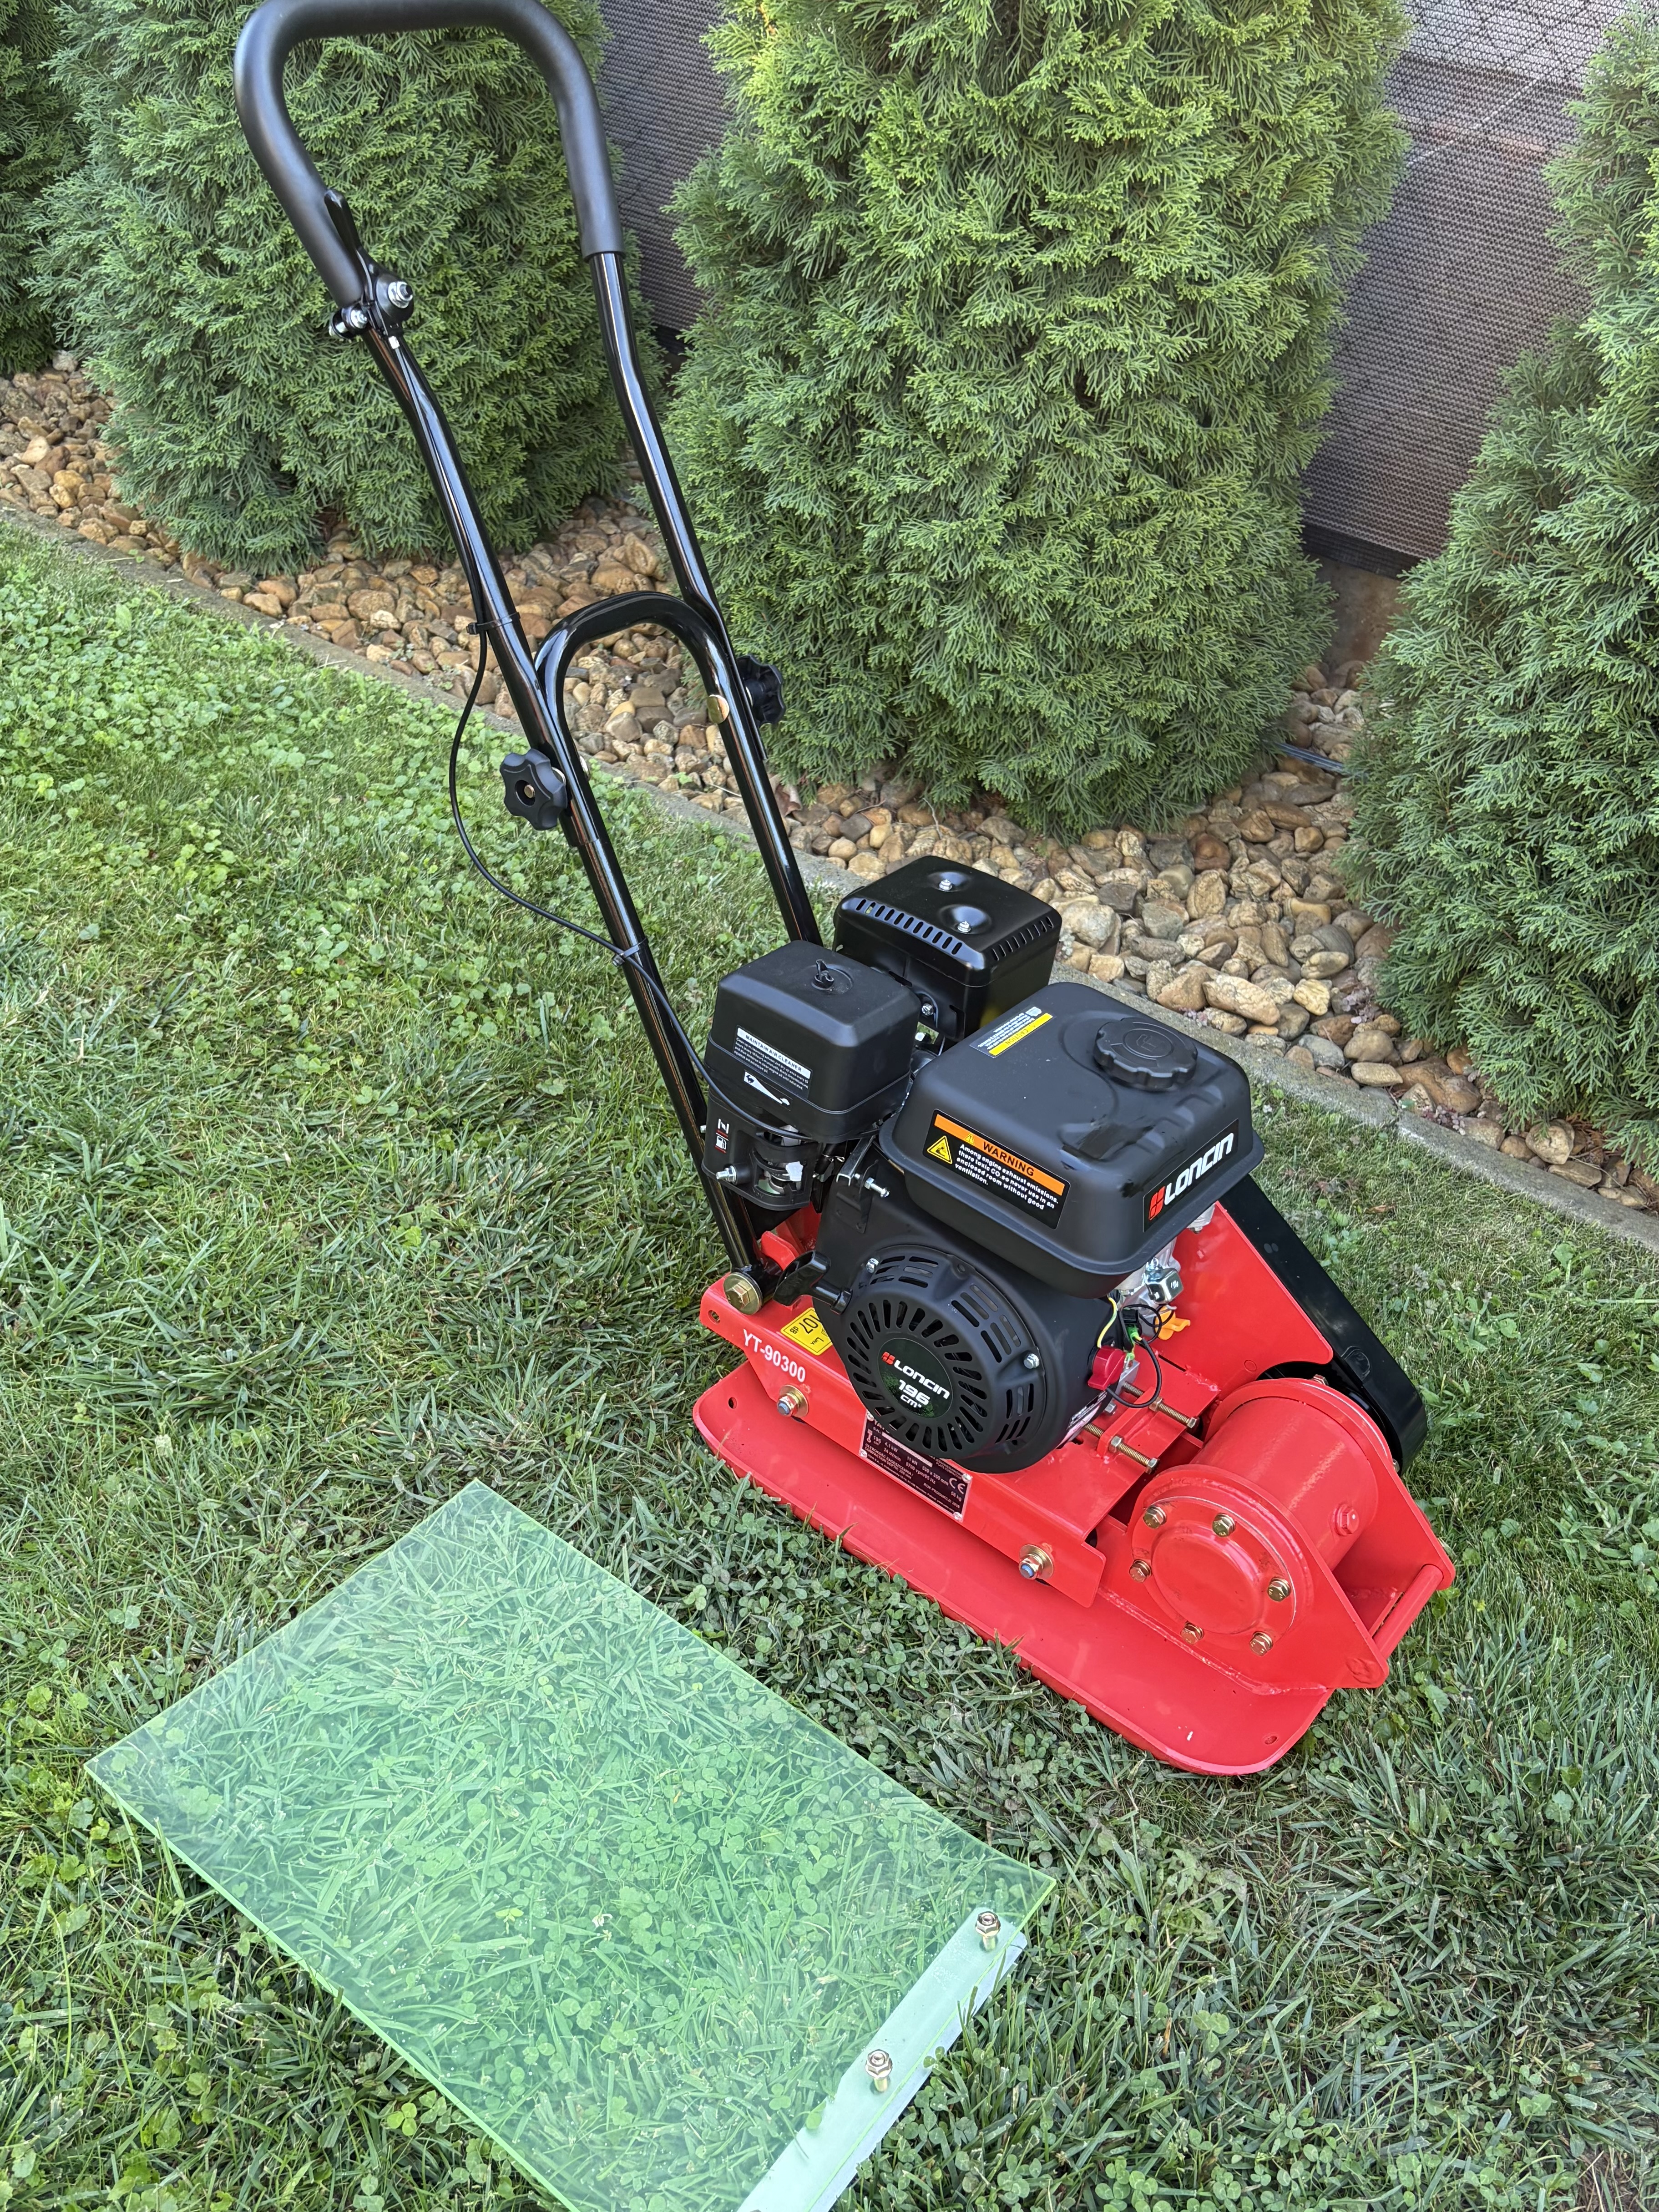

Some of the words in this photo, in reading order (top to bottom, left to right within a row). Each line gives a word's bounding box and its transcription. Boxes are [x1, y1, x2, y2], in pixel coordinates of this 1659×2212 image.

[746, 1035, 769, 1051] MAINTAIN
[778, 1055, 802, 1072] CLEANER
[1003, 1028, 1026, 1046] CAUTION
[955, 1162, 988, 1185] ventilation.
[958, 1150, 974, 1162] there
[975, 1159, 990, 1171] toxic
[1010, 1179, 1027, 1192] never
[1028, 1190, 1039, 1200] use
[960, 1144, 981, 1159] Among
[982, 1156, 1001, 1171] engine
[1002, 1168, 1027, 1184] exhaust
[1027, 1182, 1059, 1204] emissions.
[982, 1142, 1035, 1177] WARNING
[1164, 1133, 1234, 1205] LONCIN
[956, 1156, 985, 1176] enclosed
[986, 1173, 1001, 1186] room
[1003, 1182, 1027, 1200] without
[1027, 1197, 1044, 1211] good
[789, 1326, 799, 1334] dB
[743, 1328, 806, 1382] YT-90300
[894, 1359, 950, 1400] LONCIN
[898, 1379, 931, 1406] 196
[889, 1451, 900, 1461] m/min
